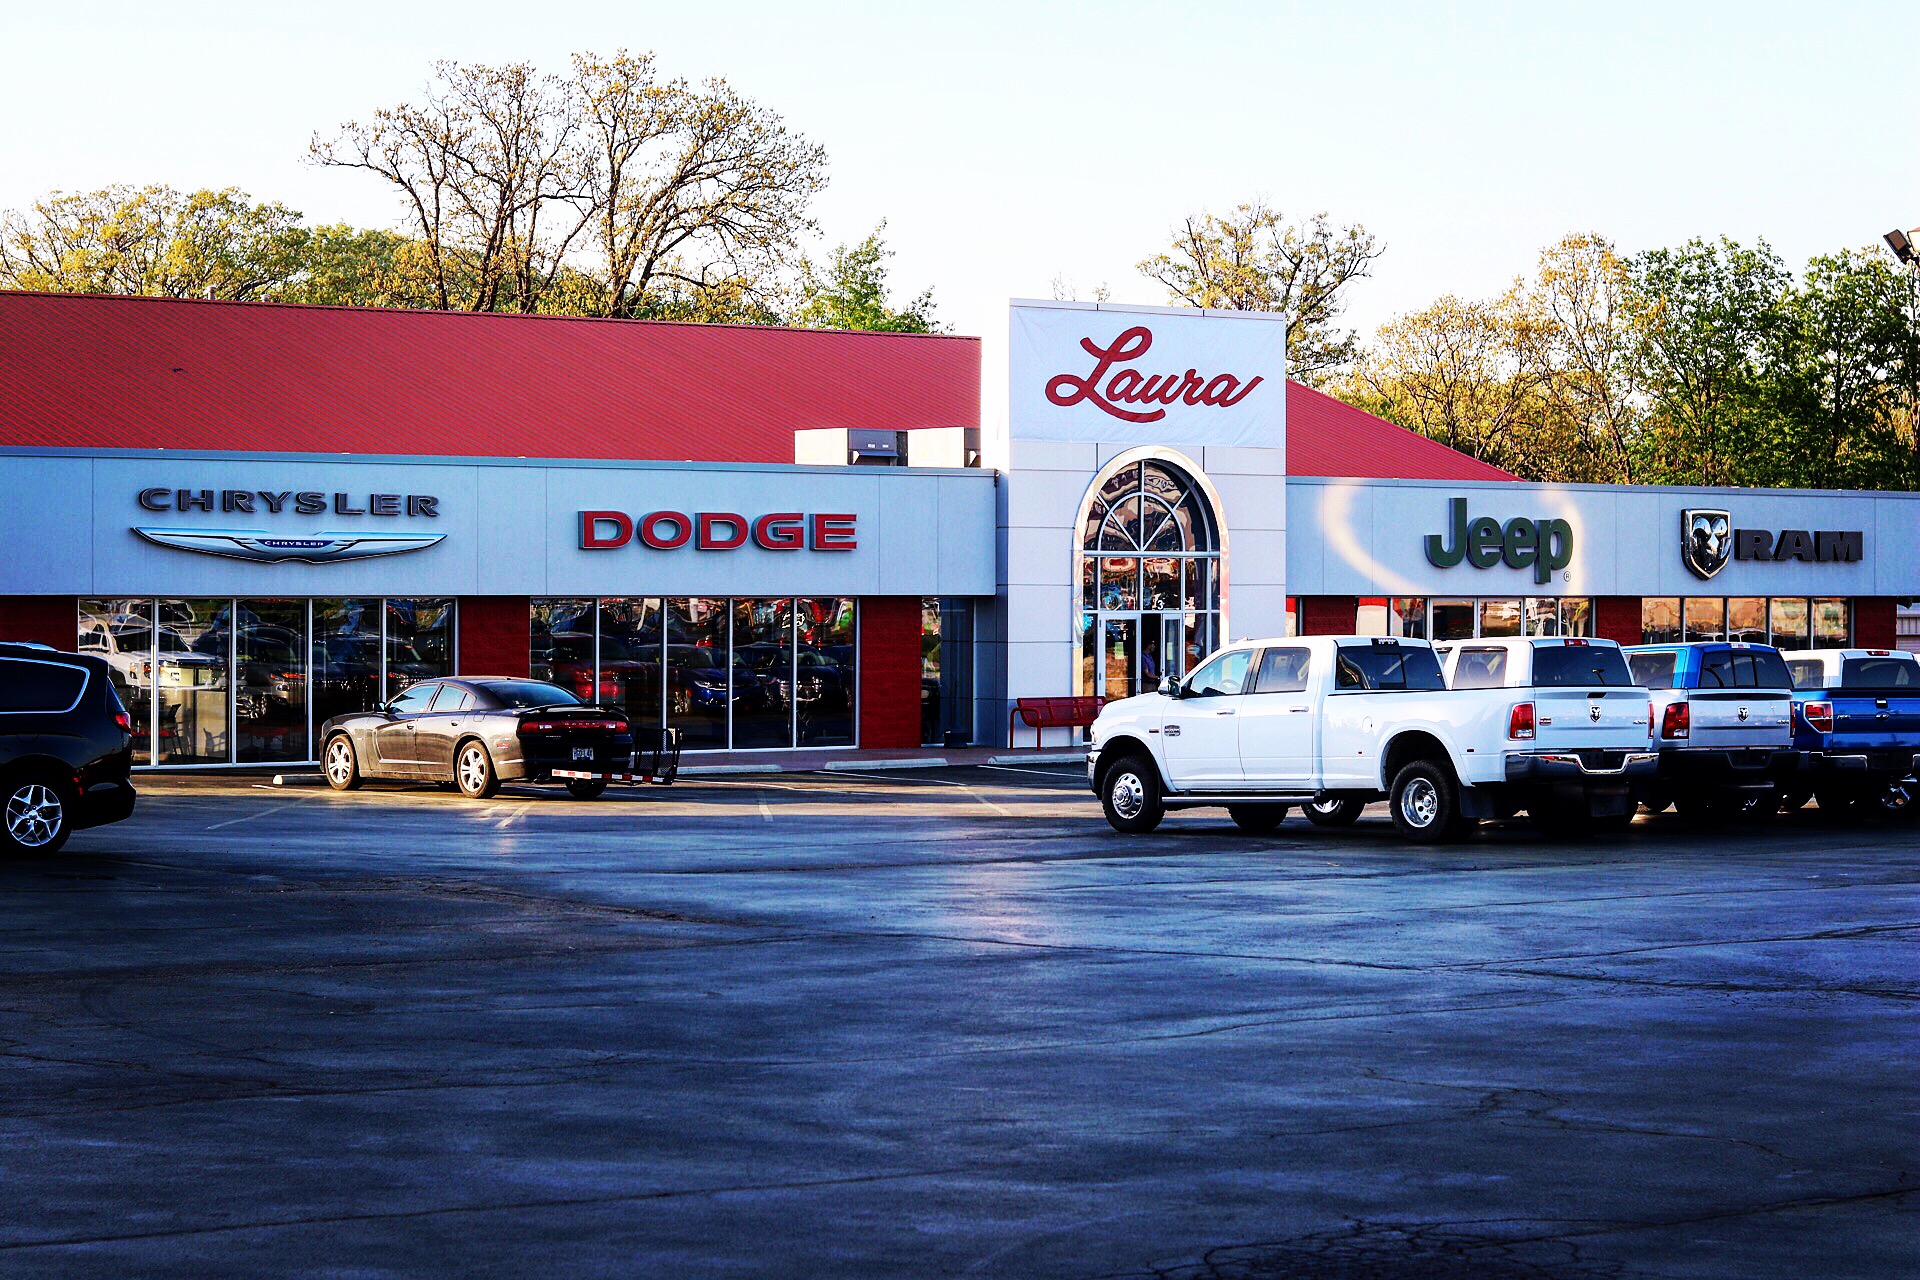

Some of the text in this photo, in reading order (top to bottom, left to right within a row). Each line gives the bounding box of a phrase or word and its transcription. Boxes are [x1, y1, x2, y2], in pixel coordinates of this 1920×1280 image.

[1045, 326, 1264, 423] Laura
[138, 487, 440, 517] CHRYSLER
[577, 510, 858, 551] DODGE
[1424, 497, 1573, 584] Jeep
[1734, 529, 1864, 561] RAM
